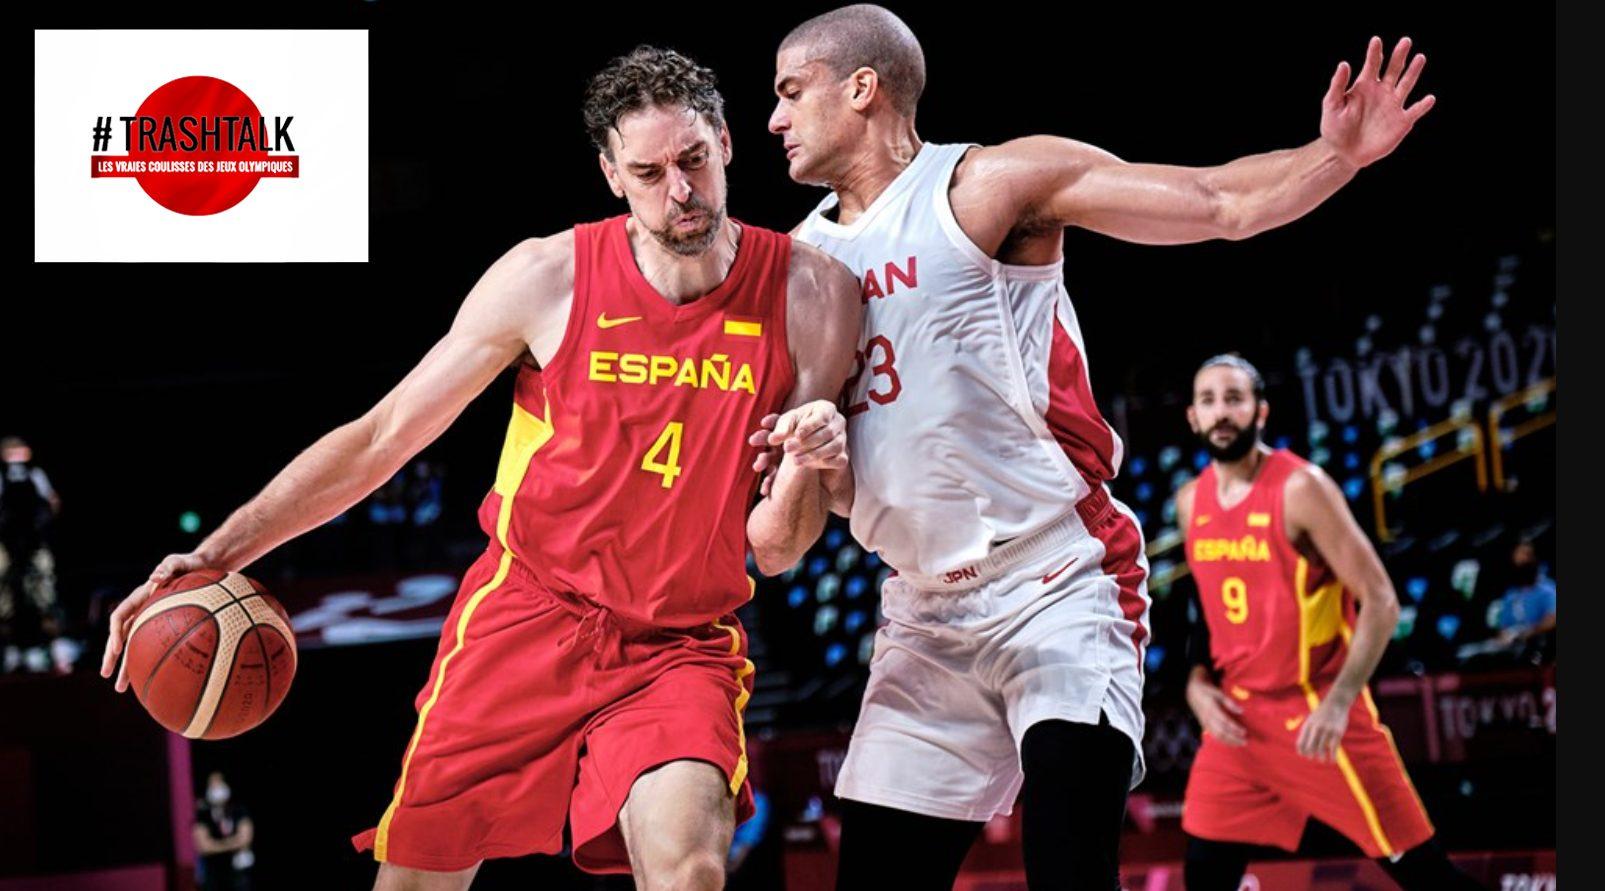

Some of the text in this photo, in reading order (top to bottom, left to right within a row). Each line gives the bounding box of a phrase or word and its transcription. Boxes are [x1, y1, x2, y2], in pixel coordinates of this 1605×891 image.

[858, 256, 918, 305] AN
[588, 351, 756, 395] ESPAÑA
[840, 334, 902, 418] 23
[1296, 324, 1556, 424] TOKYO 202
[641, 421, 684, 490] 4
[1193, 534, 1271, 562] ESPAÑA
[943, 565, 978, 584] JPN
[1222, 576, 1249, 624] 9
